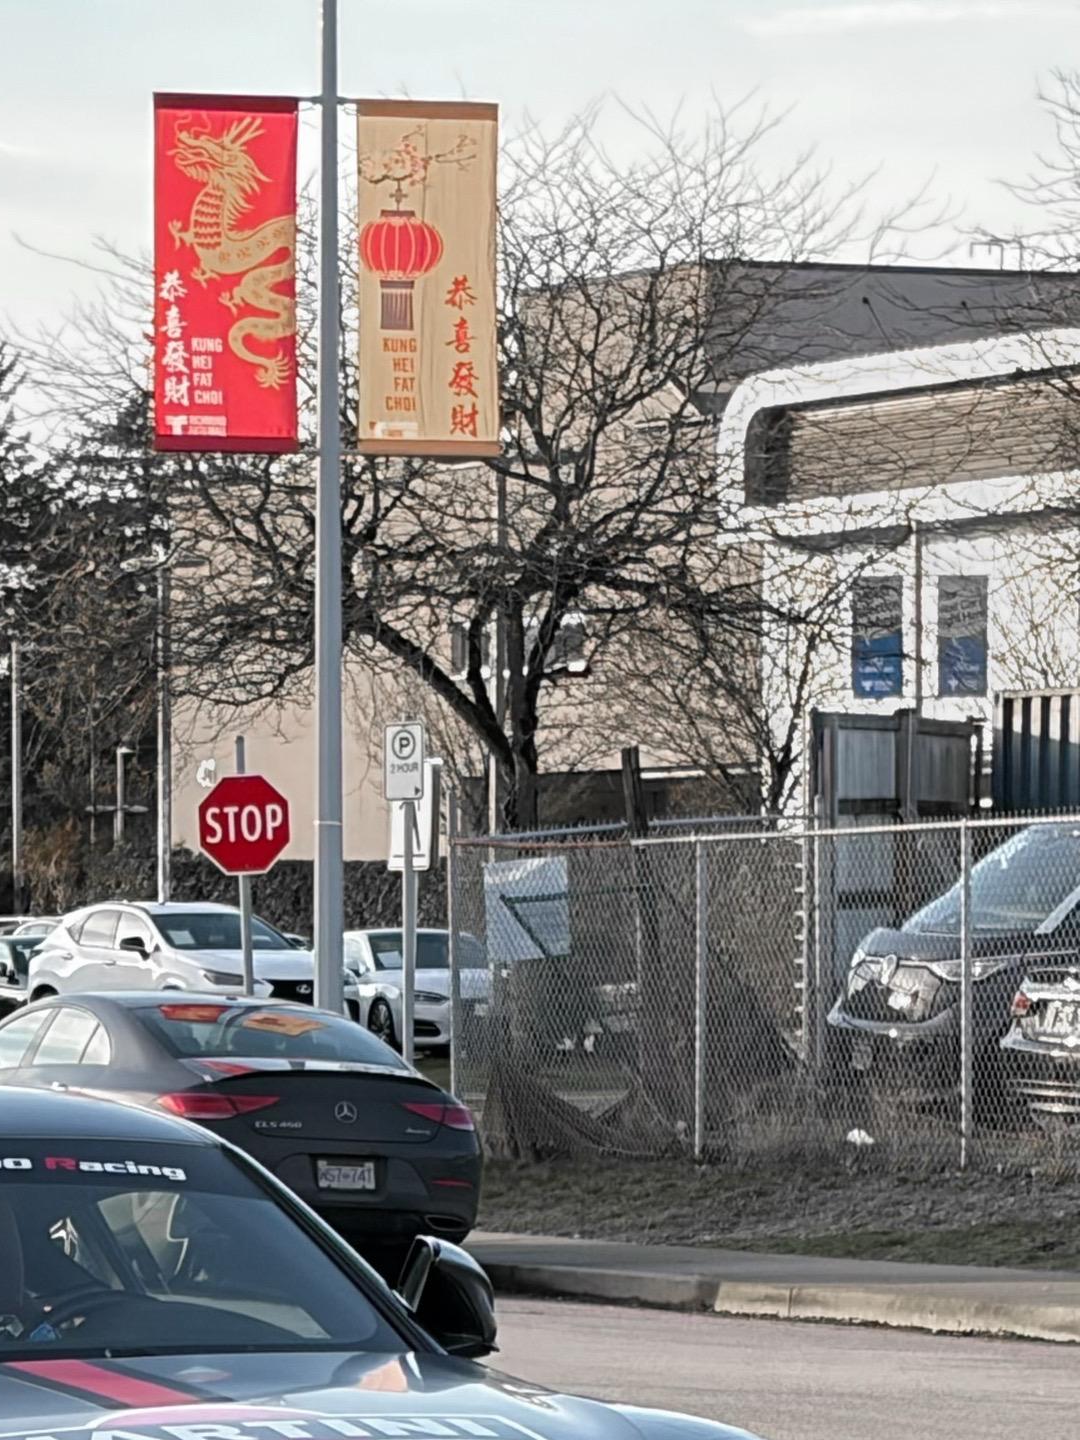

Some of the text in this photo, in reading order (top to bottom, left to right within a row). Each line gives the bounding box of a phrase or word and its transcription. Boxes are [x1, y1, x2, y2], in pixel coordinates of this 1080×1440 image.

[159, 269, 190, 407] 恭喜發財
[191, 337, 223, 353] KUNG
[383, 338, 417, 352] KUNG
[444, 274, 480, 438] 恭喜發財
[393, 357, 414, 373] HEI
[193, 372, 213, 387] FAT
[394, 377, 415, 392] FAT
[194, 389, 223, 405] CHOI
[386, 396, 416, 411] CHOI
[205, 803, 283, 844] STOP
[44, 1157, 187, 1181] Racing
